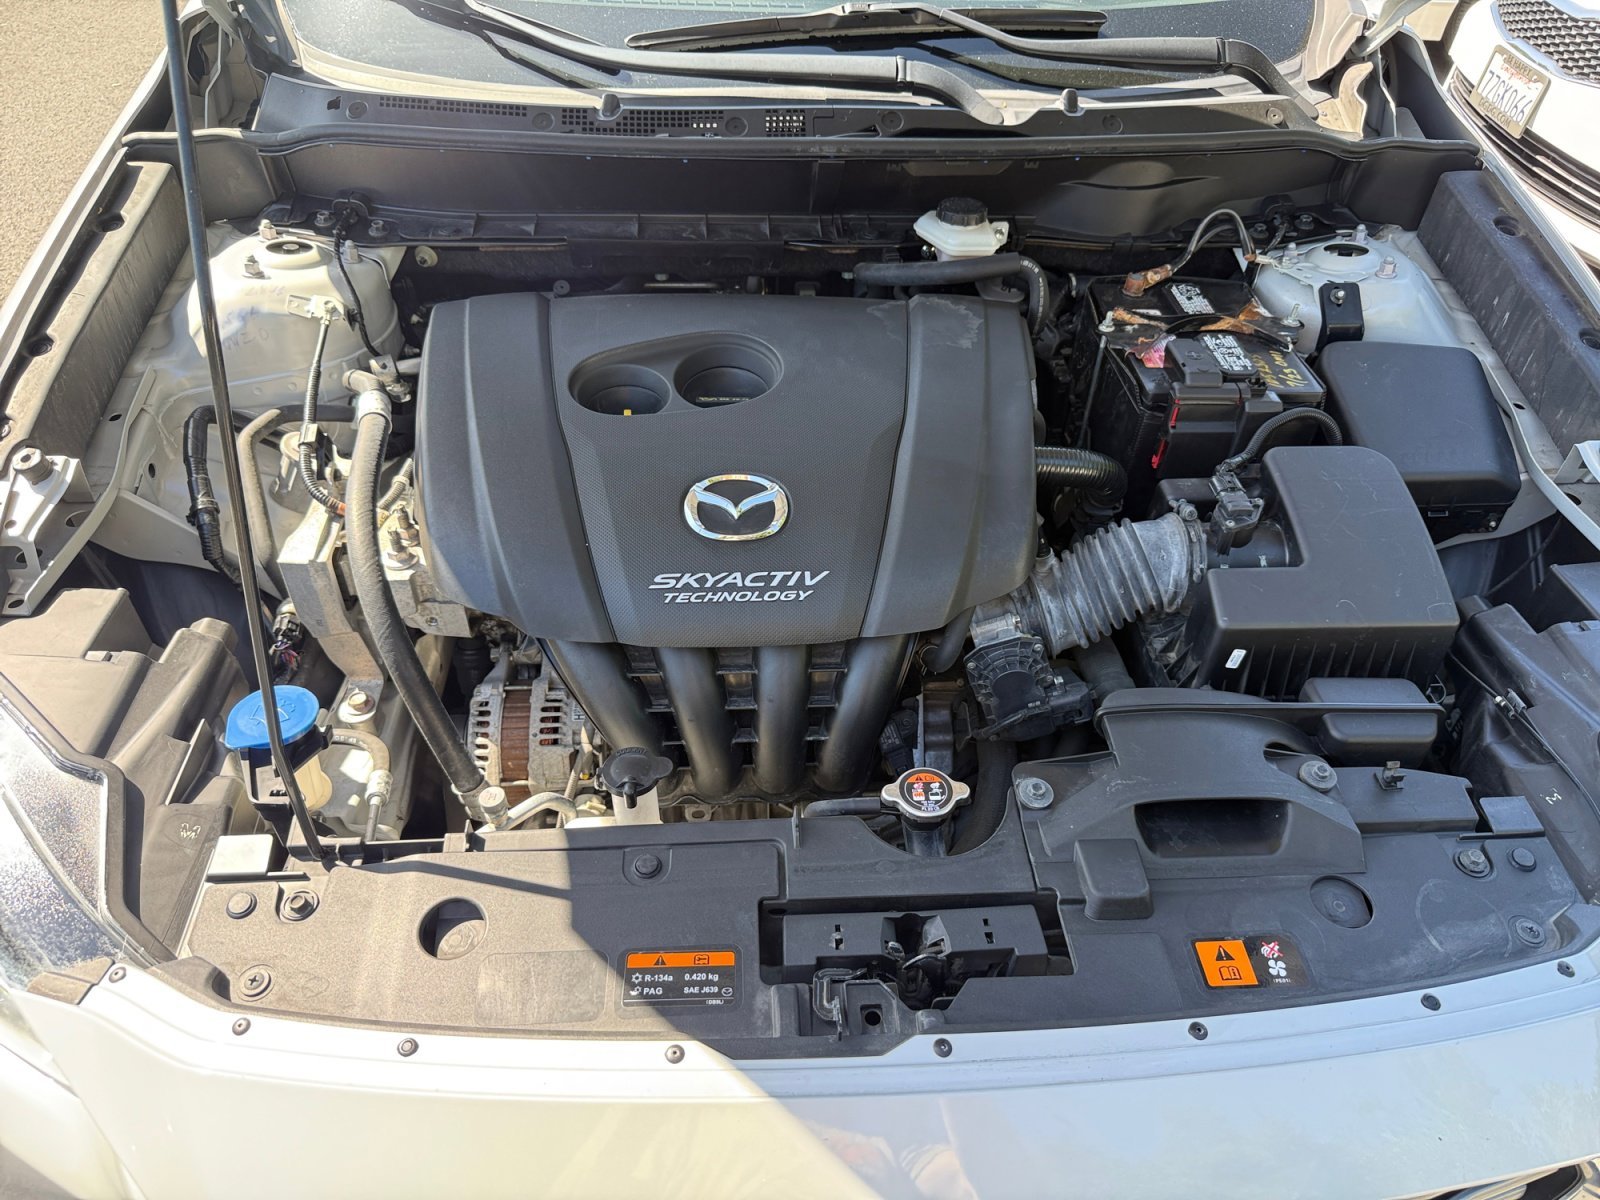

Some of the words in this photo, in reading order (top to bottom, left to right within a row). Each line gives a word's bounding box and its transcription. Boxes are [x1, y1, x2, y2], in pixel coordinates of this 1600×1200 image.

[648, 570, 831, 590] SKYACTIV
[663, 590, 815, 604] TECHNOLOGY
[644, 973, 673, 982] R-134a
[684, 973, 707, 981] 0.420
[708, 972, 719, 982] kg
[643, 987, 663, 995] PAG
[683, 986, 699, 994] SAE
[701, 986, 719, 994] J639
